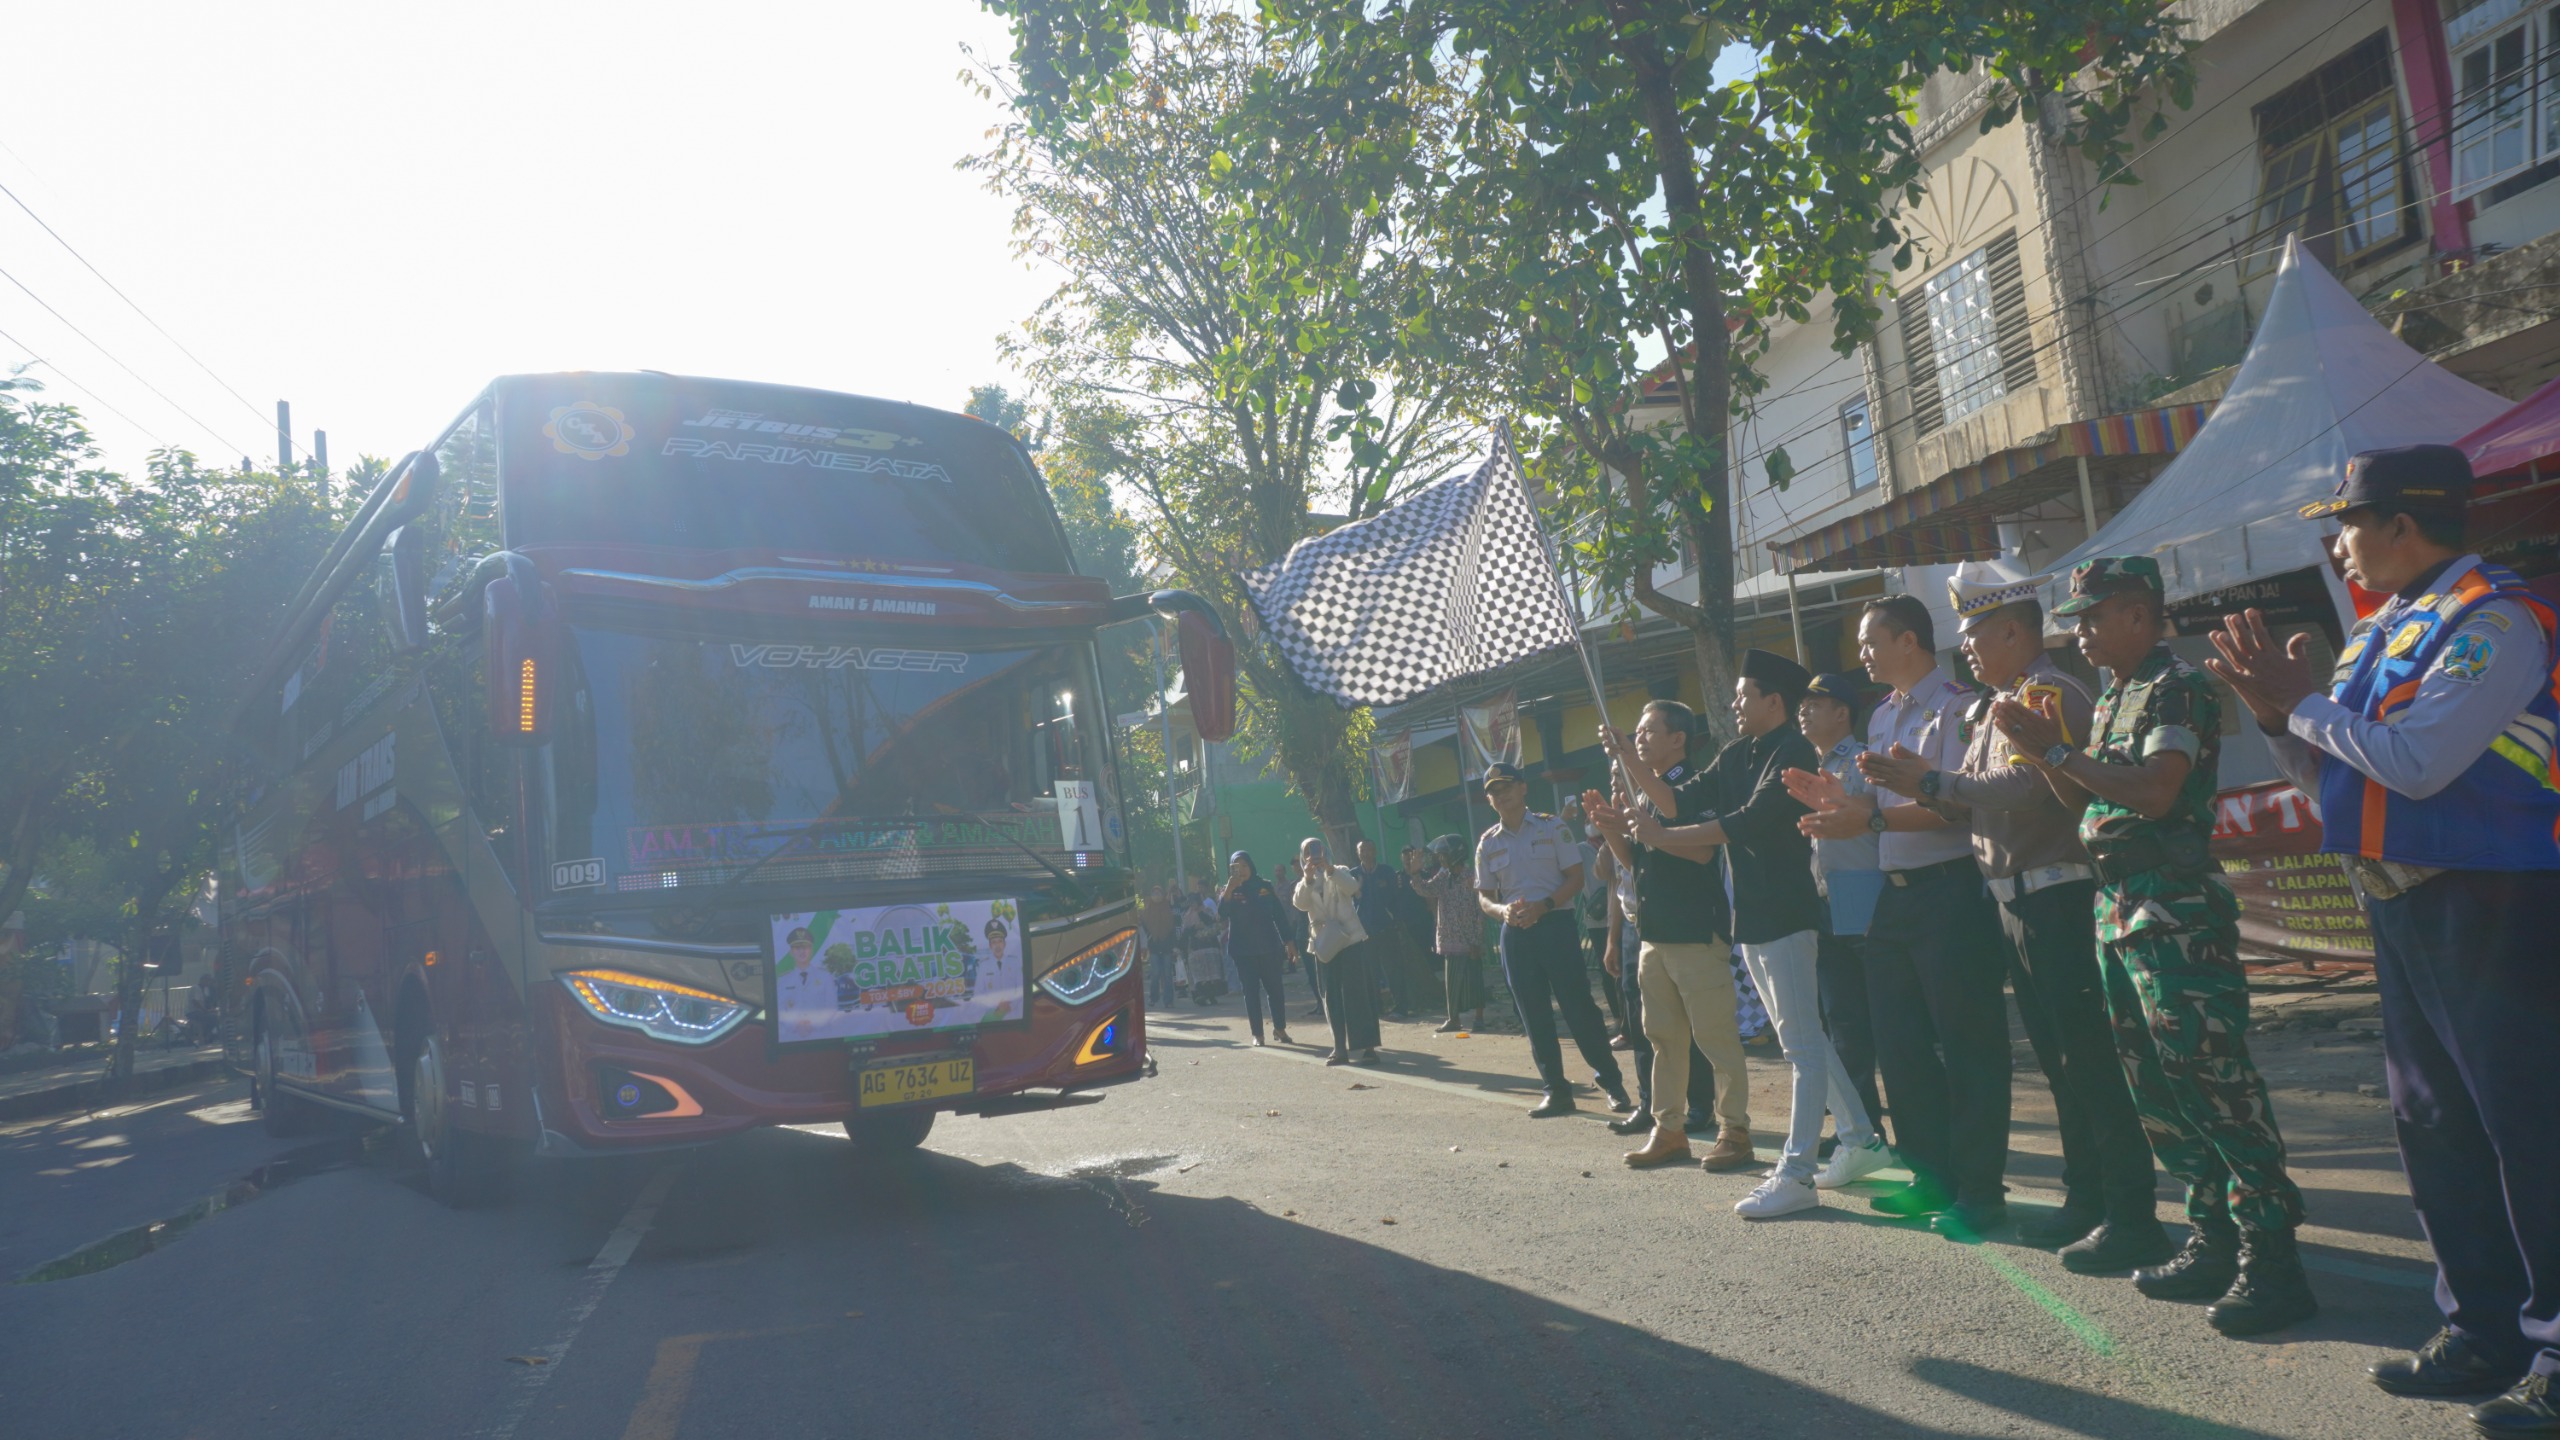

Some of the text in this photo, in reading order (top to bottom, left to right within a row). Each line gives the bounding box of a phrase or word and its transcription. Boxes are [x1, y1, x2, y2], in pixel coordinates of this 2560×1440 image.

[682, 415, 841, 440] JETBUS
[661, 436, 952, 484] PARIWISATA
[809, 595, 937, 616] AMAN & AMANAH
[729, 644, 969, 674] VOYAGER
[1063, 786, 1089, 800] BUS
[1073, 805, 1092, 846] 1
[556, 864, 600, 888] 009
[2276, 874, 2350, 891] LALAPAN
[2281, 895, 2355, 910] LALAPAN
[2286, 916, 2367, 930] RICA RICA
[855, 925, 958, 960] BALIK
[2288, 936, 2329, 950] NASI
[854, 952, 964, 988] GRATIS
[925, 977, 966, 1000] 2025
[863, 1061, 971, 1095] AG 7634 UZ
